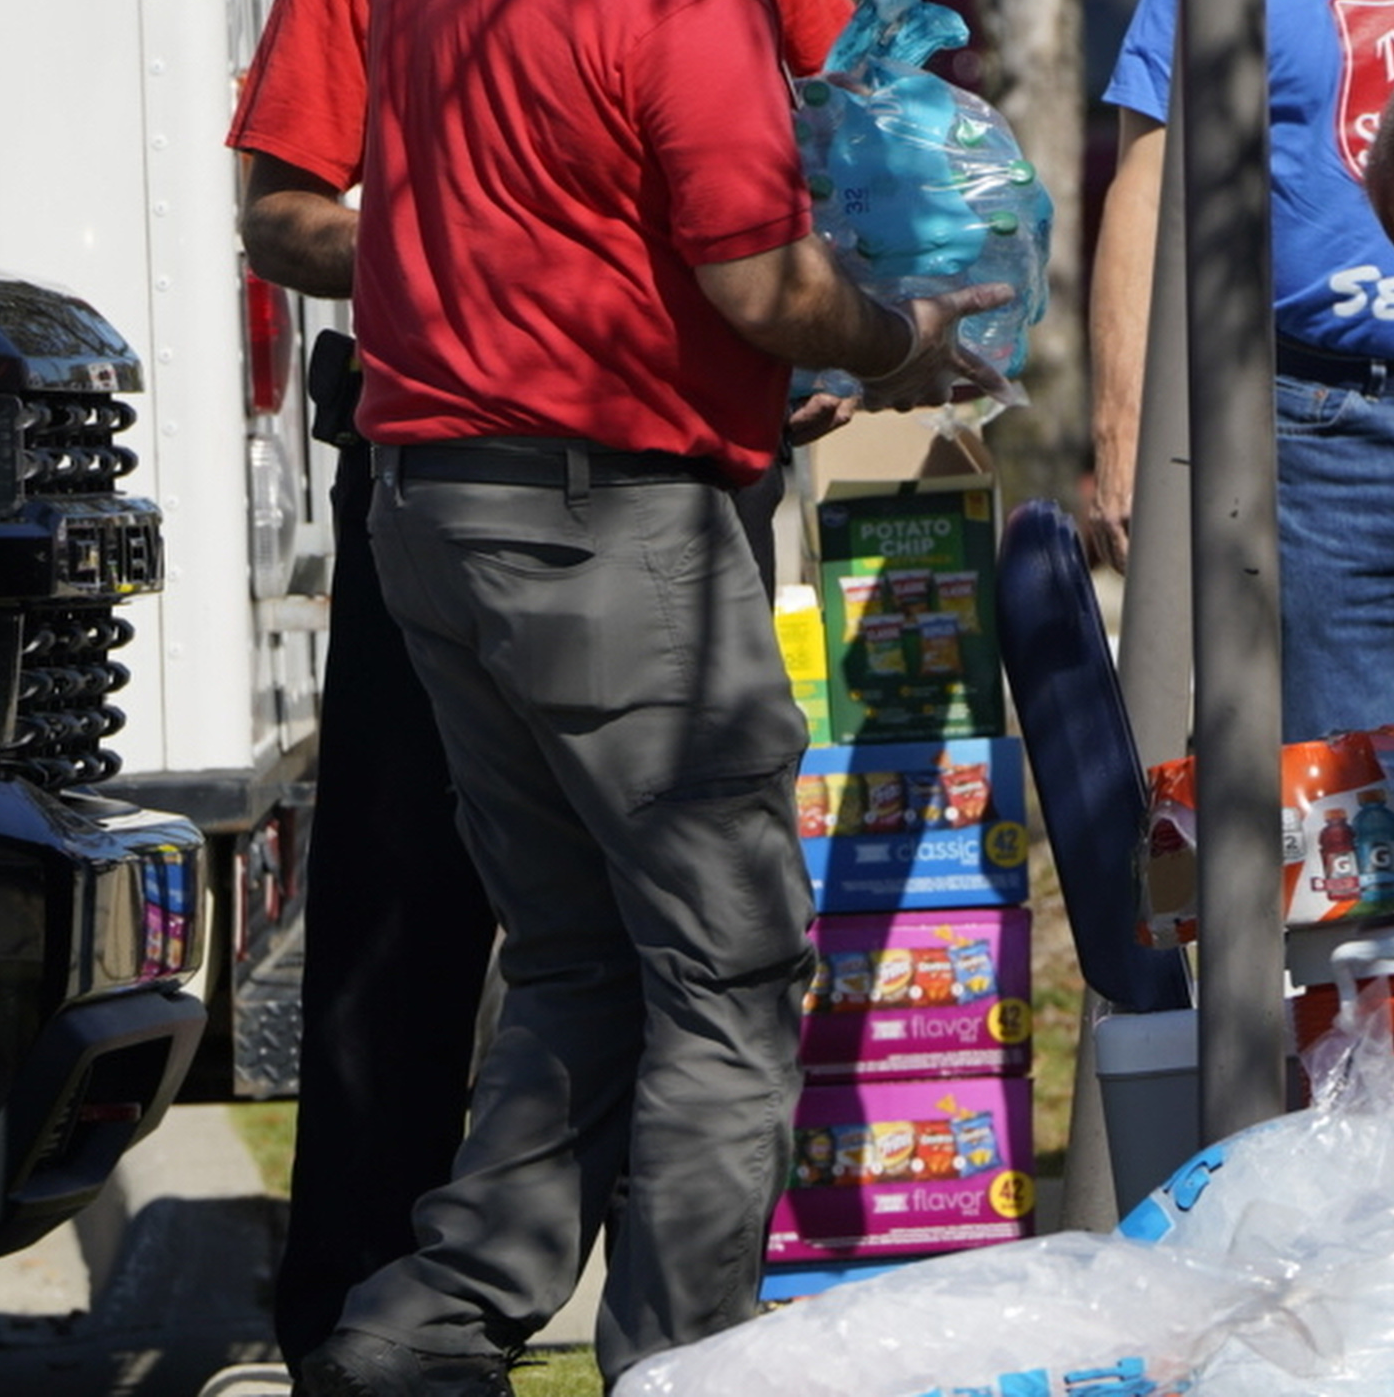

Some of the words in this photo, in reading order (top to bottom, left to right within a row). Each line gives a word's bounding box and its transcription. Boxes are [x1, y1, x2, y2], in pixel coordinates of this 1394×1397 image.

[844, 187, 864, 215] 32
[861, 519, 952, 540] POTATO
[879, 538, 935, 556] CHIP
[896, 836, 979, 862] classic
[995, 828, 1019, 852] 42
[1333, 855, 1351, 874] G
[911, 1015, 983, 1039] flavor
[999, 1004, 1022, 1028] 42
[912, 1187, 985, 1212] flavor
[998, 1178, 1026, 1203] 42
